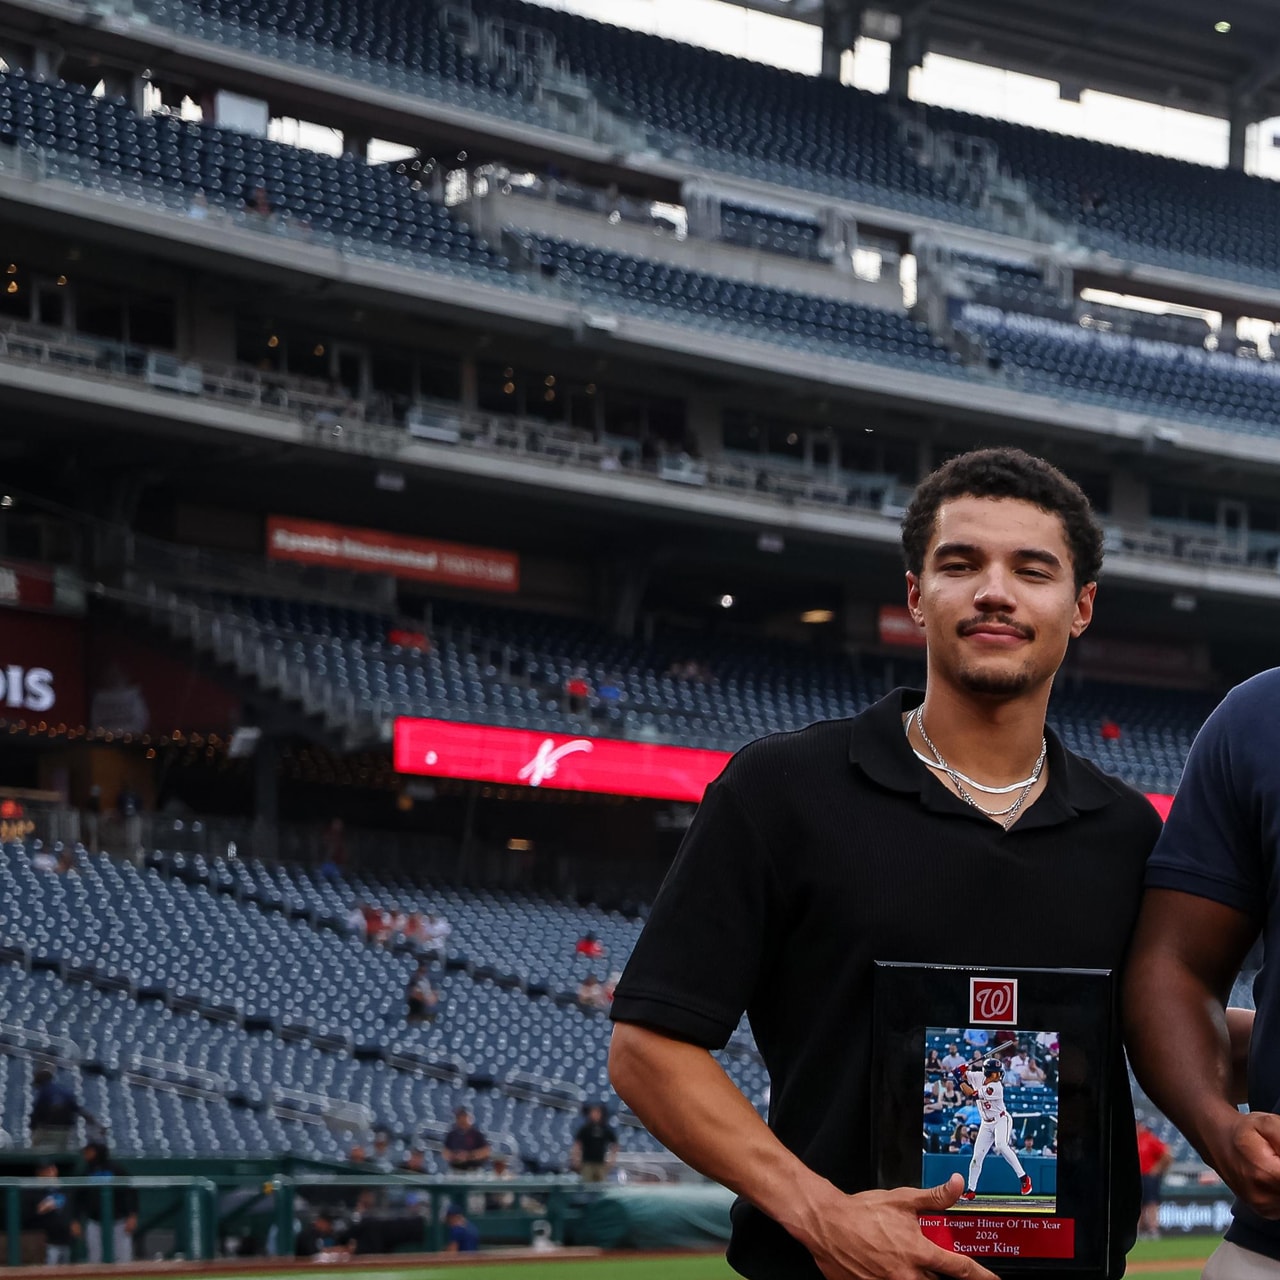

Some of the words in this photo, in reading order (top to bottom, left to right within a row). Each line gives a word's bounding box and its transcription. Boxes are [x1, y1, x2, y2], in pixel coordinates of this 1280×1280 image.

[0, 664, 56, 713] IS
[943, 1218, 975, 1229] League
[977, 1219, 1005, 1228] Hitter
[1006, 1219, 1020, 1228] Of
[1021, 1219, 1040, 1229] The
[1041, 1220, 1061, 1229] Year
[975, 1231, 999, 1240] 2026
[953, 1241, 990, 1252] Seaver
[993, 1242, 1020, 1255] King
